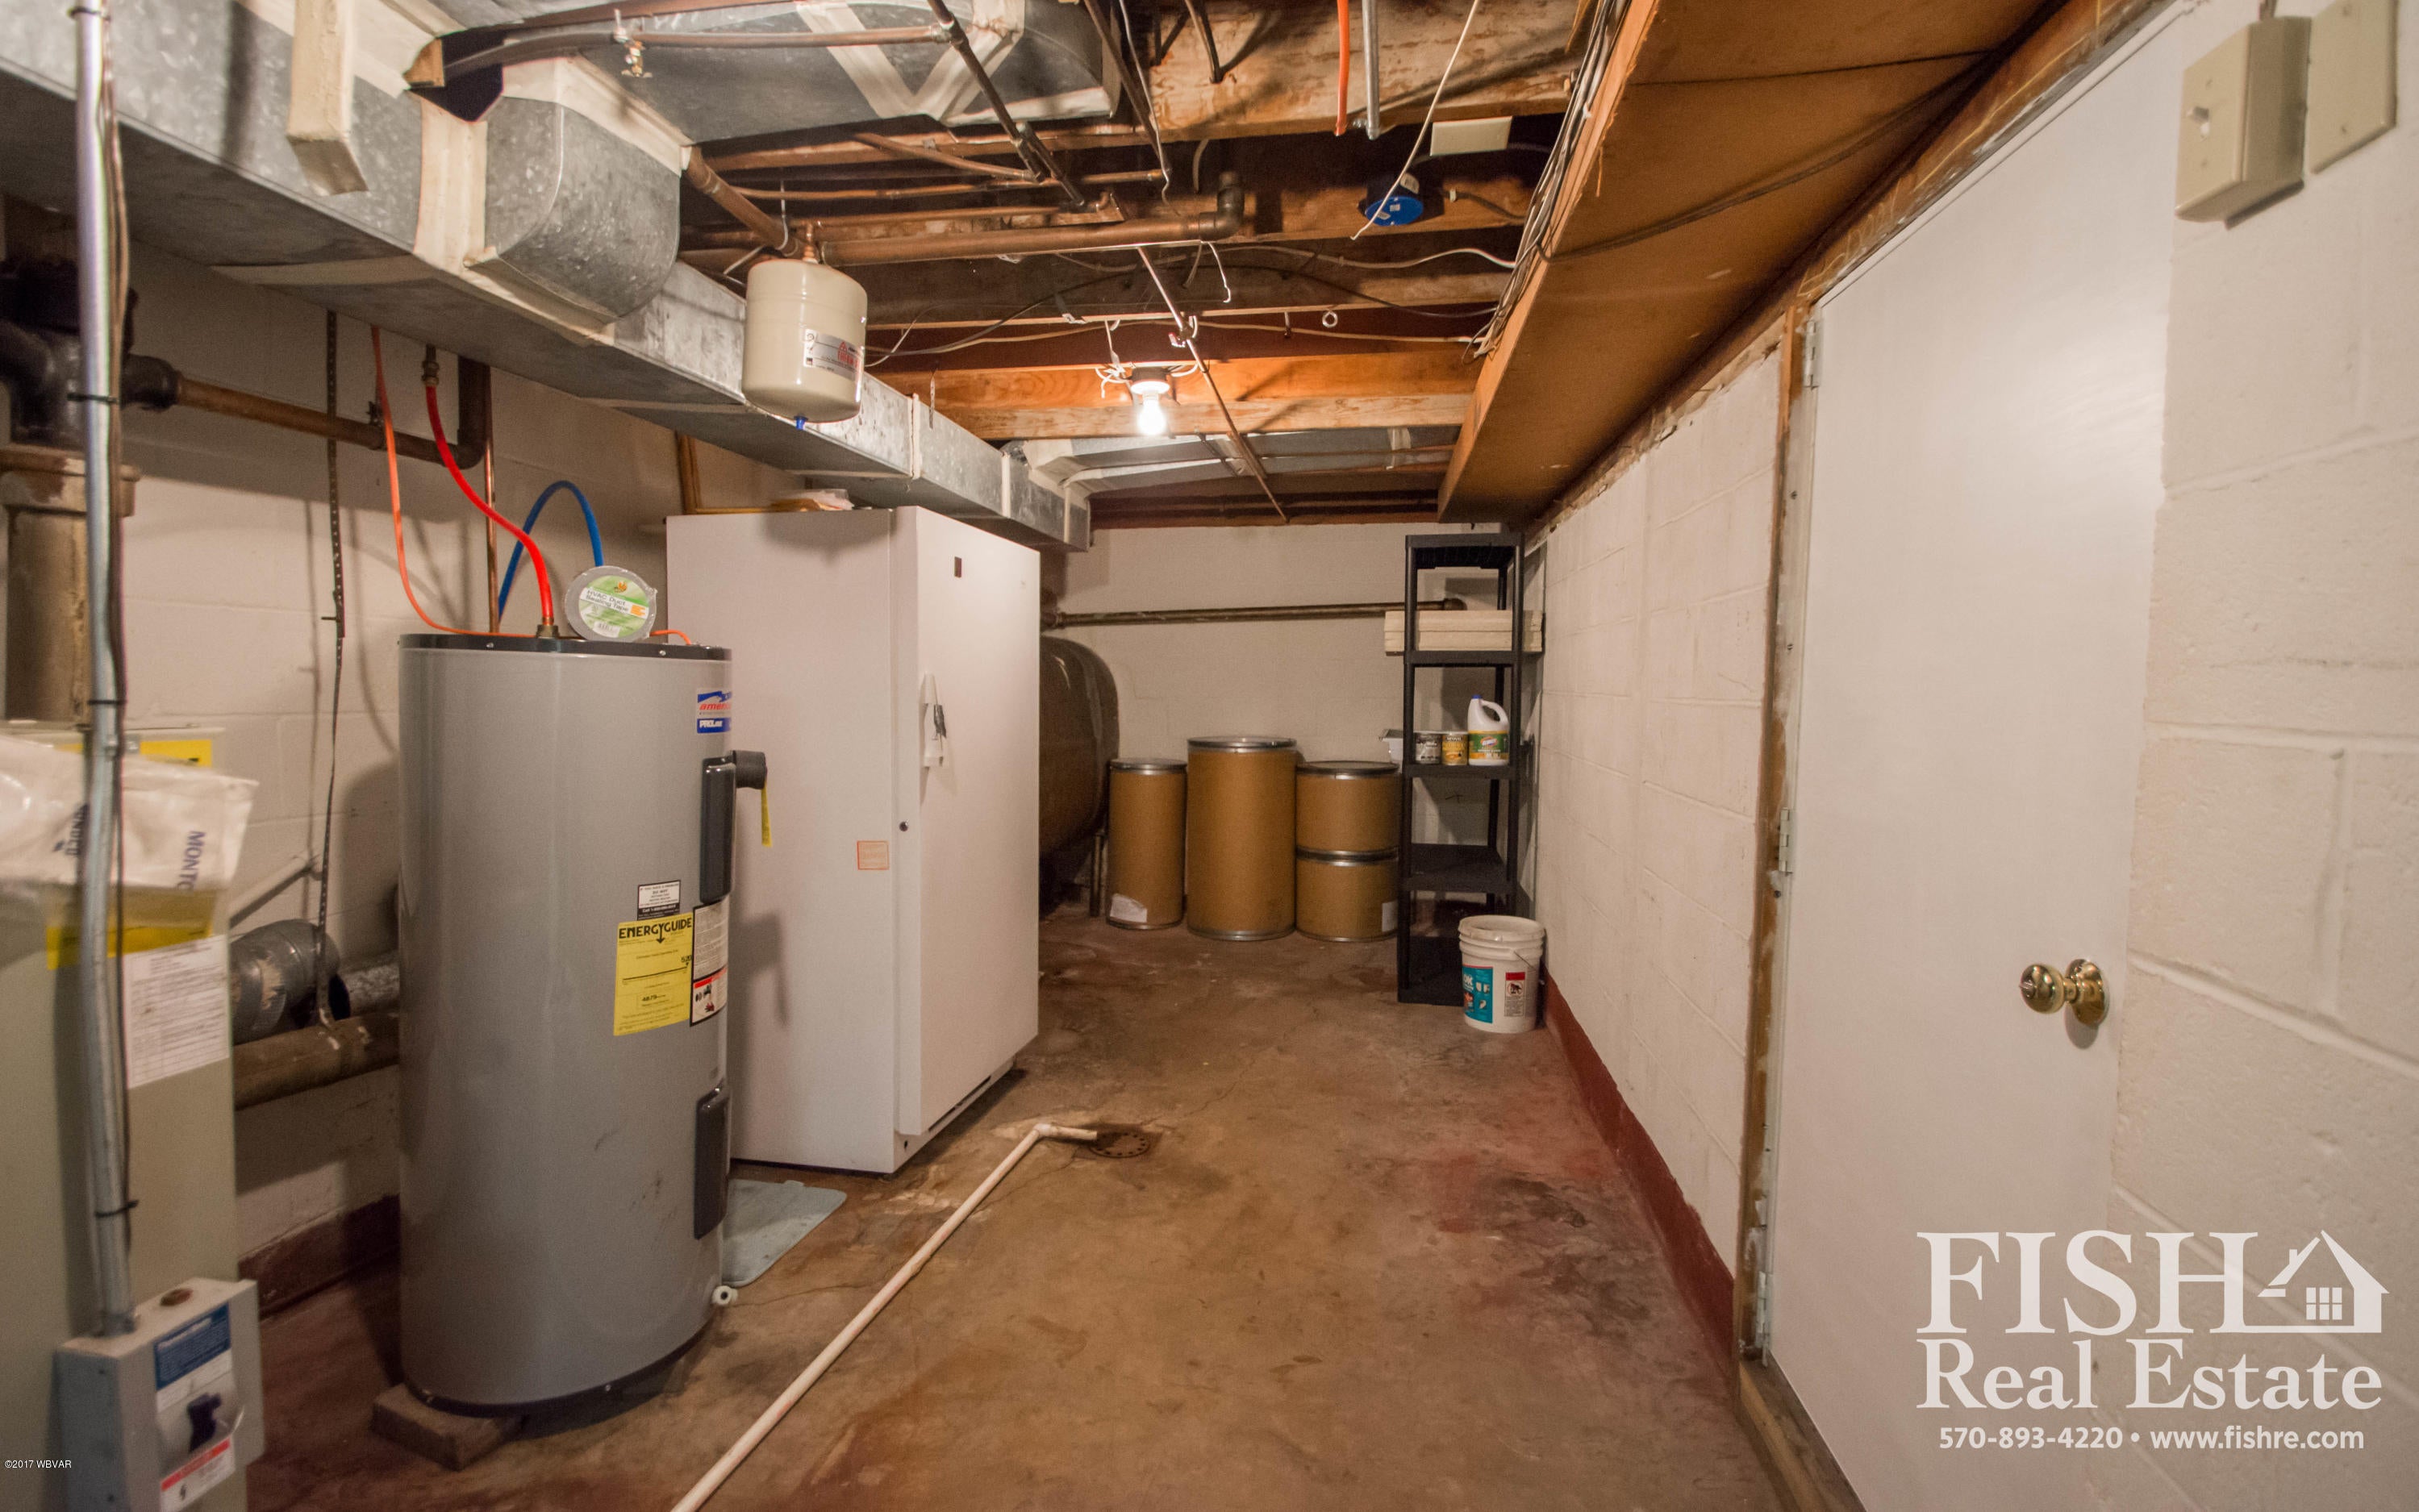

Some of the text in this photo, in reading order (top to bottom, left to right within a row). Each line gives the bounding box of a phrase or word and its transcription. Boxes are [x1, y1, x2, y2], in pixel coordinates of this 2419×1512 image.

[587, 589, 607, 599] HVAC
[609, 596, 626, 606] Duct
[619, 917, 693, 941] ENERGYGUIDE
